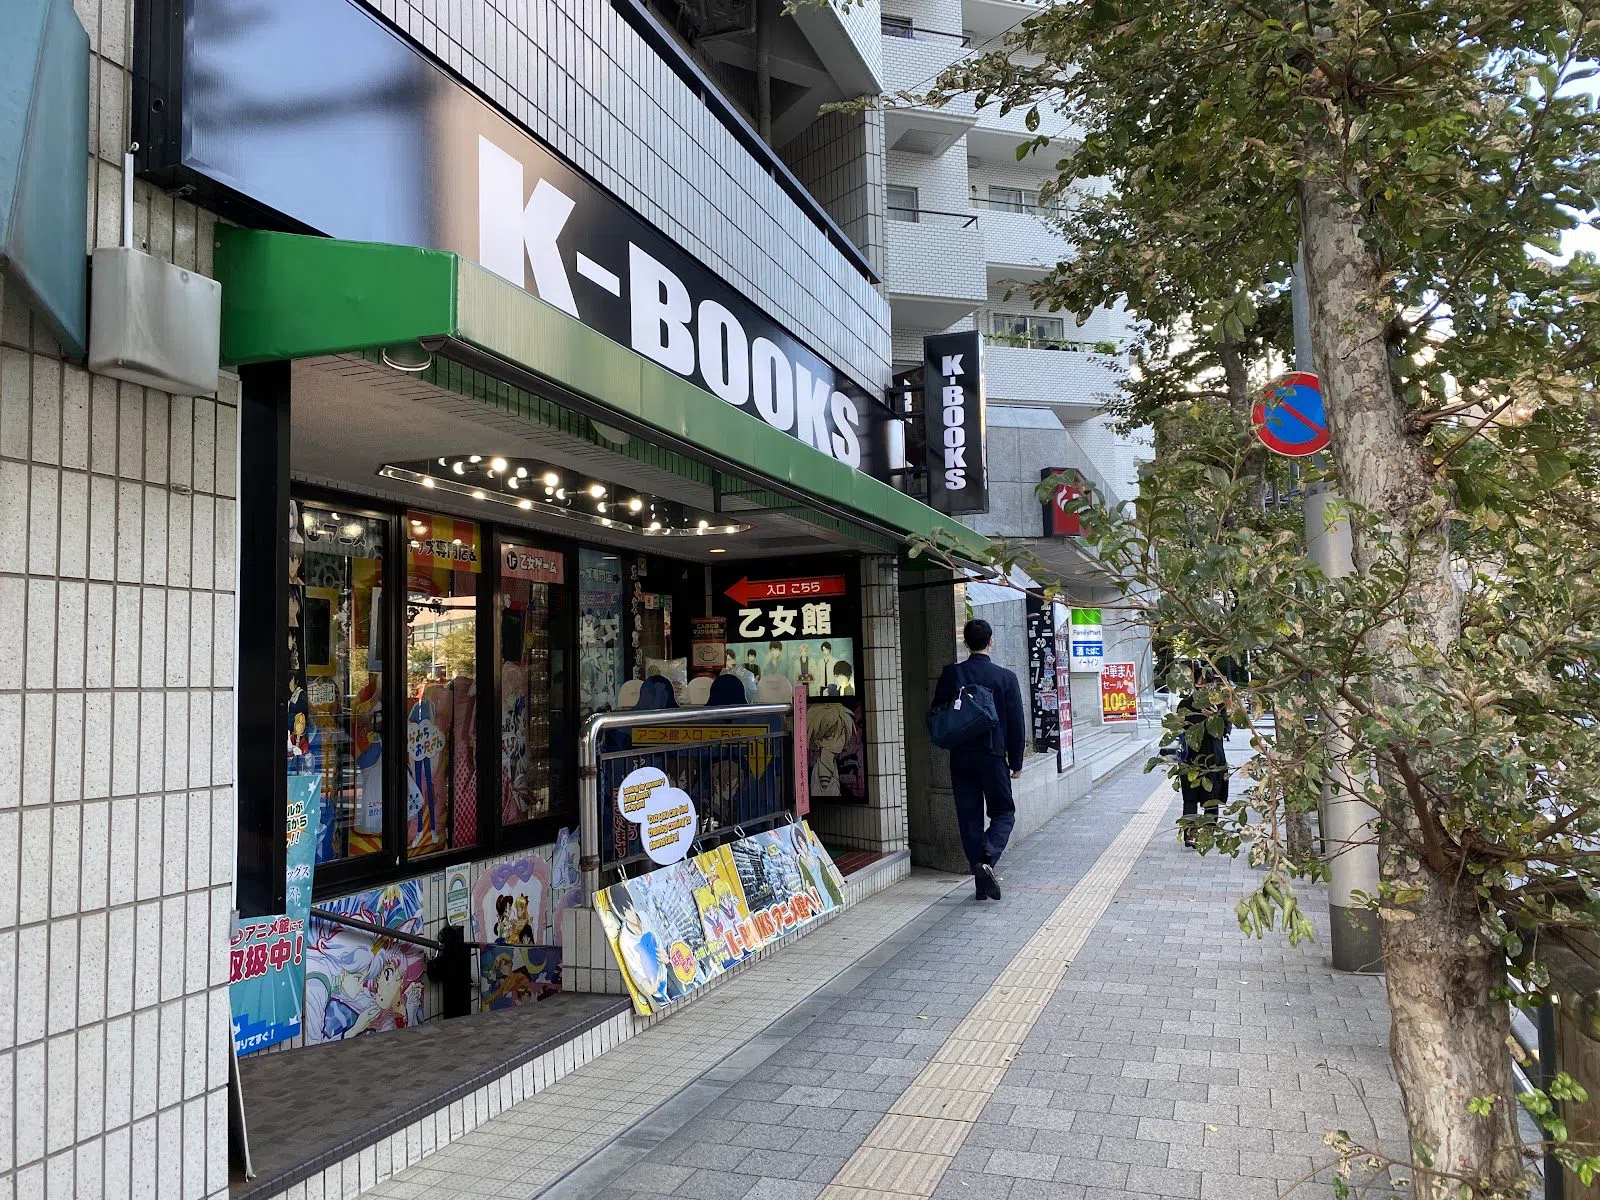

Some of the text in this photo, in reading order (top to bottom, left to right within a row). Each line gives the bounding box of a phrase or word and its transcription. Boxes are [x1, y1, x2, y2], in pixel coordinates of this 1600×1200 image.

[479, 134, 862, 469] K-BOOKS
[941, 353, 968, 490] K-BOOKS
[767, 581, 821, 595] 入口 こちら
[738, 601, 832, 638] 乙女館
[1073, 629, 1102, 637] FamilyMart
[1086, 647, 1101, 655] たばこ
[1102, 664, 1134, 679] 中華まん
[1102, 680, 1123, 690] セール
